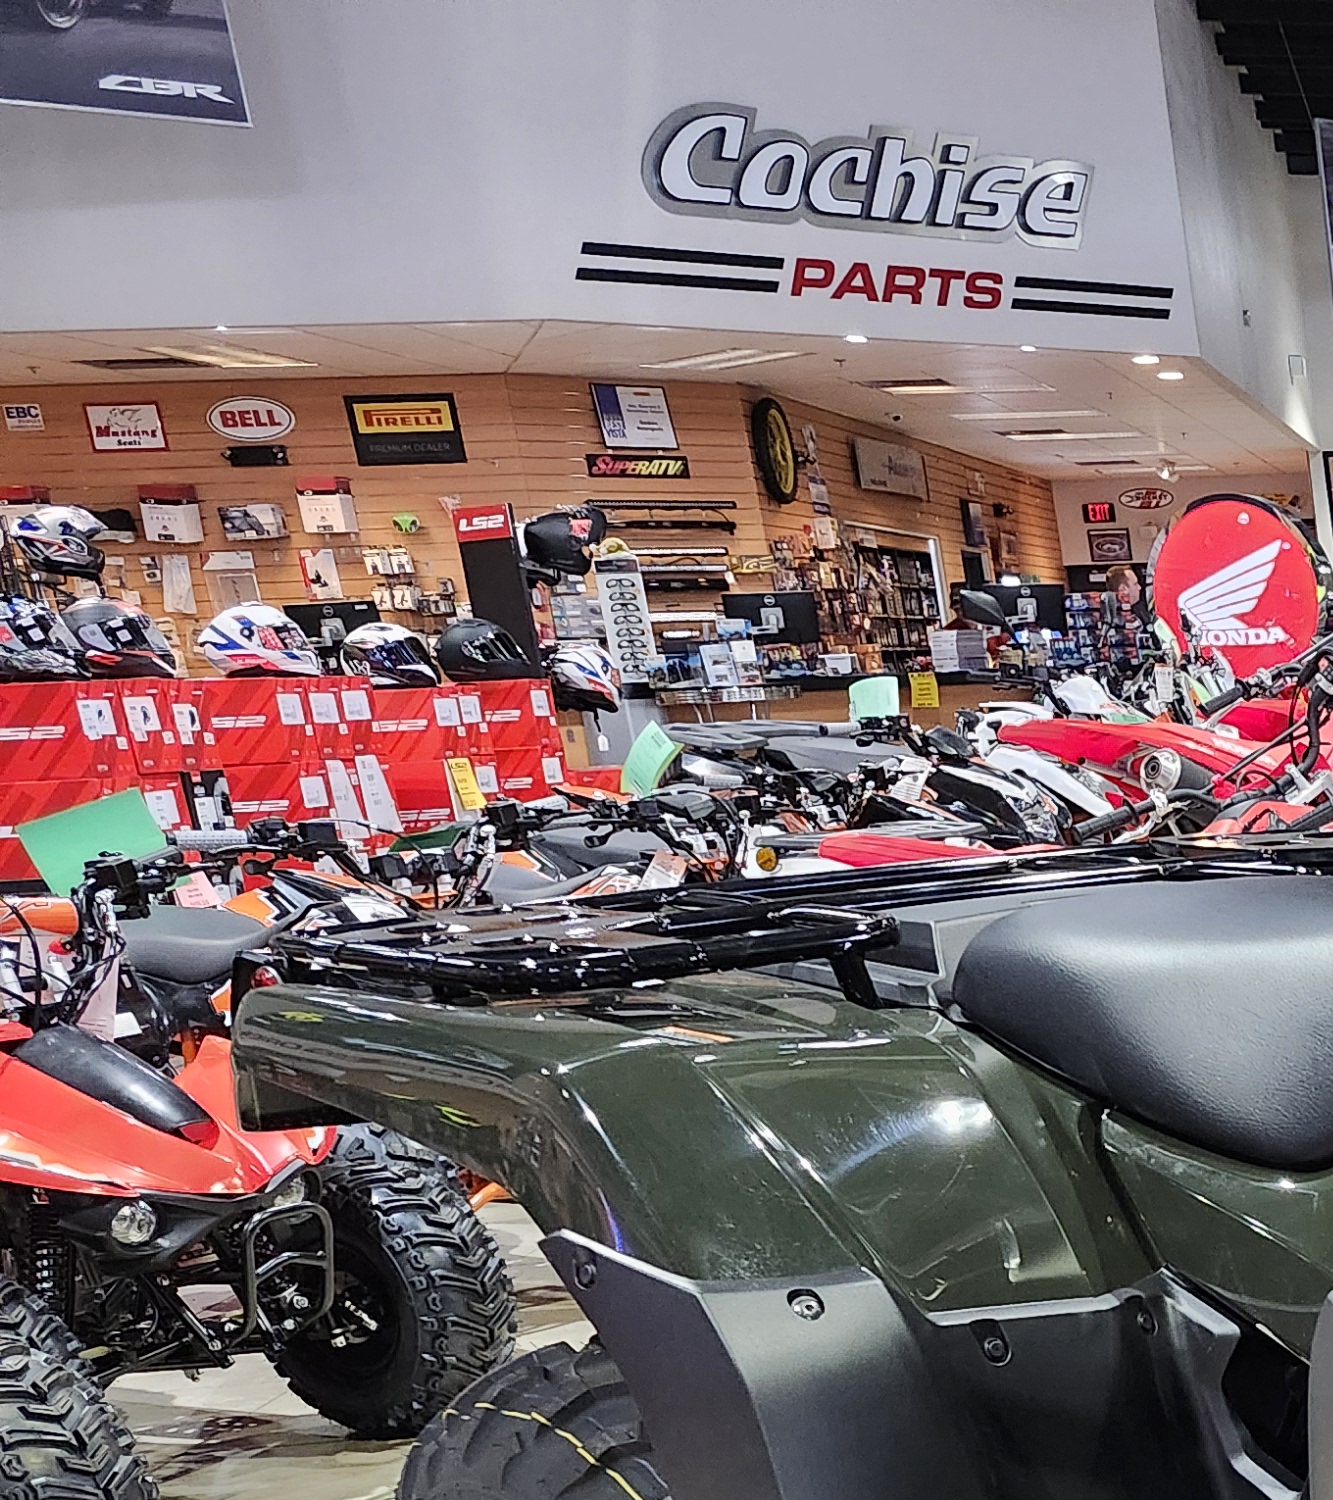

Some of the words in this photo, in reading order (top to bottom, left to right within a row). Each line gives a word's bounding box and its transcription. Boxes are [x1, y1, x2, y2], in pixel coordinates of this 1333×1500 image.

[98, 74, 236, 105] CBR
[655, 111, 1091, 239] Cochise
[790, 257, 1003, 310] PARTS
[5, 405, 39, 419] EBC
[219, 408, 282, 430] BELL
[362, 407, 444, 428] PIRELLI
[95, 425, 157, 438] Mustang
[457, 513, 505, 532] LS2
[1088, 503, 1110, 522] EXIT
